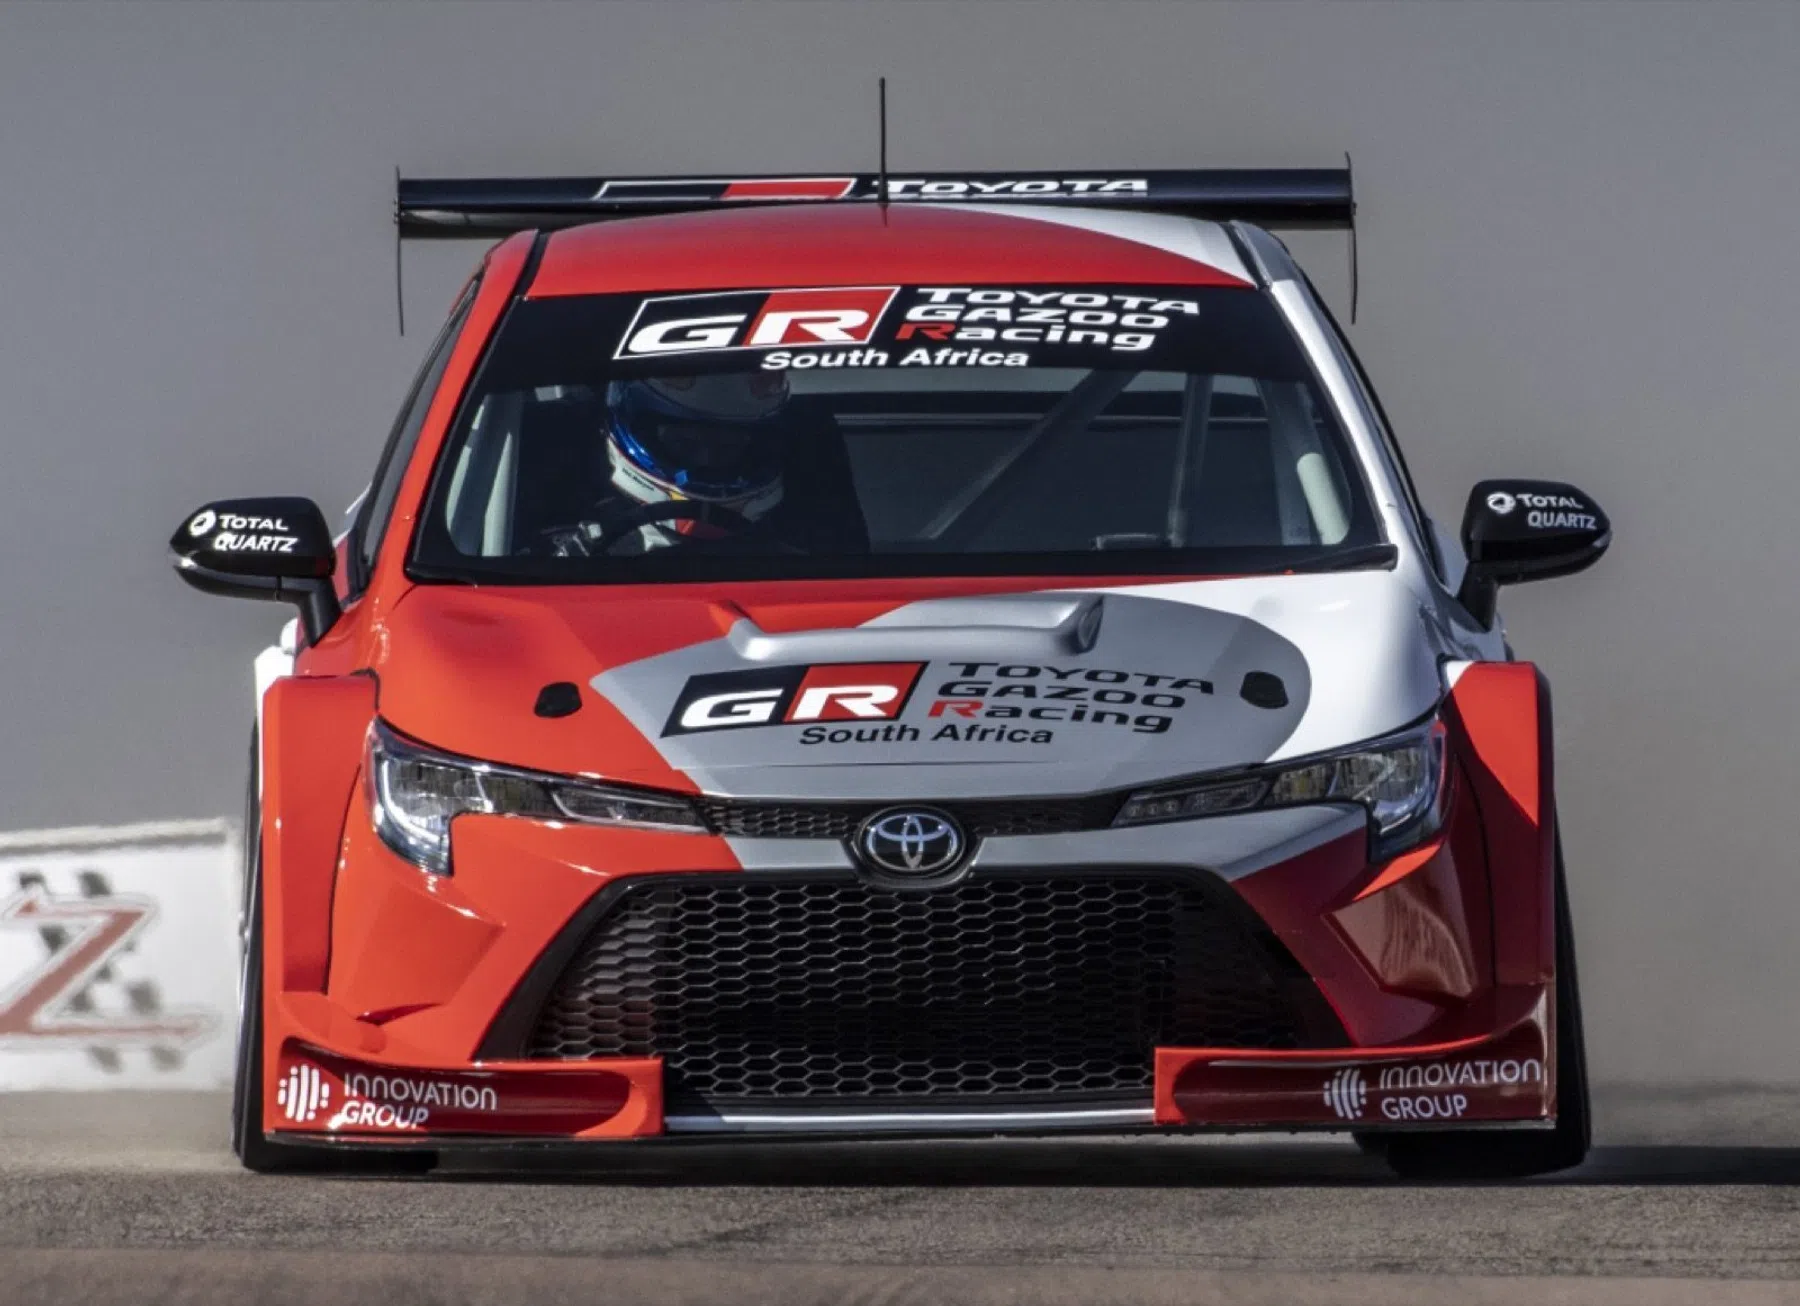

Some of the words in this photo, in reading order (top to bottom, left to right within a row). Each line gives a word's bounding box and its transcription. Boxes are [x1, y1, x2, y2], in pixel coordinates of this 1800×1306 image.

[872, 179, 1148, 193] TOYOTA
[917, 287, 1199, 315] TOYOTA
[905, 304, 1169, 328] GAZOO
[628, 309, 870, 352] GR
[895, 323, 1155, 351] Racing
[761, 349, 888, 370] South
[899, 348, 1029, 367] Africa
[1516, 493, 1584, 509] TOTAL
[219, 513, 289, 531] TOTAL
[1527, 511, 1597, 530] QUARTZ
[213, 531, 298, 553] QUARTZ
[948, 662, 1214, 695] TOYOTA
[680, 685, 898, 729] GR
[937, 681, 1186, 708] GAZOO
[927, 701, 1173, 733] Racing
[799, 724, 919, 744] South
[930, 724, 1054, 743] Africa
[341, 1101, 429, 1129] GROUP
[1381, 1094, 1468, 1120] GROUP
